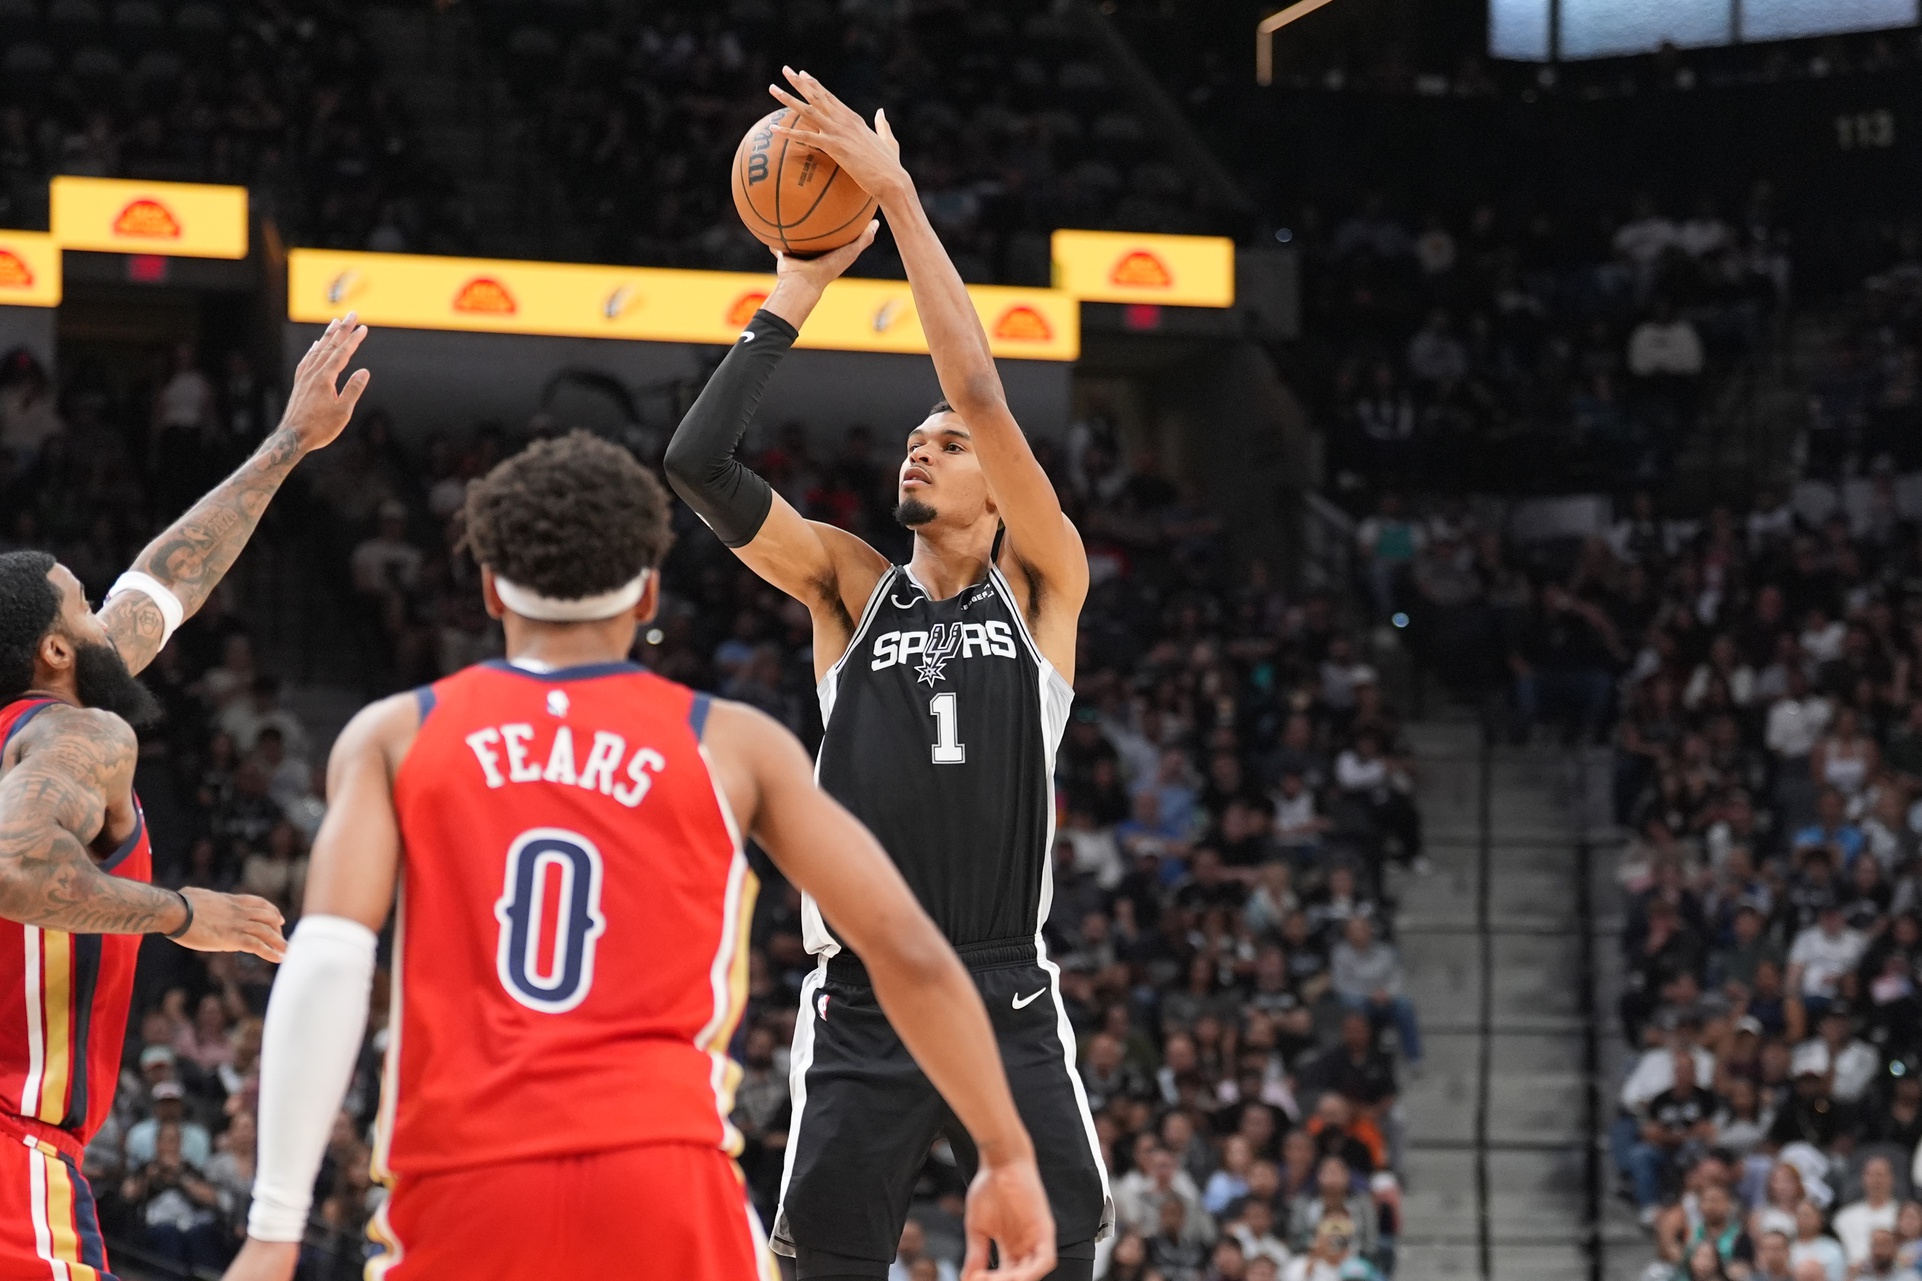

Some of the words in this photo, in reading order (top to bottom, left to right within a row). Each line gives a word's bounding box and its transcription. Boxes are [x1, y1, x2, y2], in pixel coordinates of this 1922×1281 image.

[1834, 109, 1894, 151] 113
[870, 620, 1017, 688] SPURS
[464, 722, 666, 808] FEARS
[929, 692, 966, 765] 1
[493, 827, 607, 1014] 0
